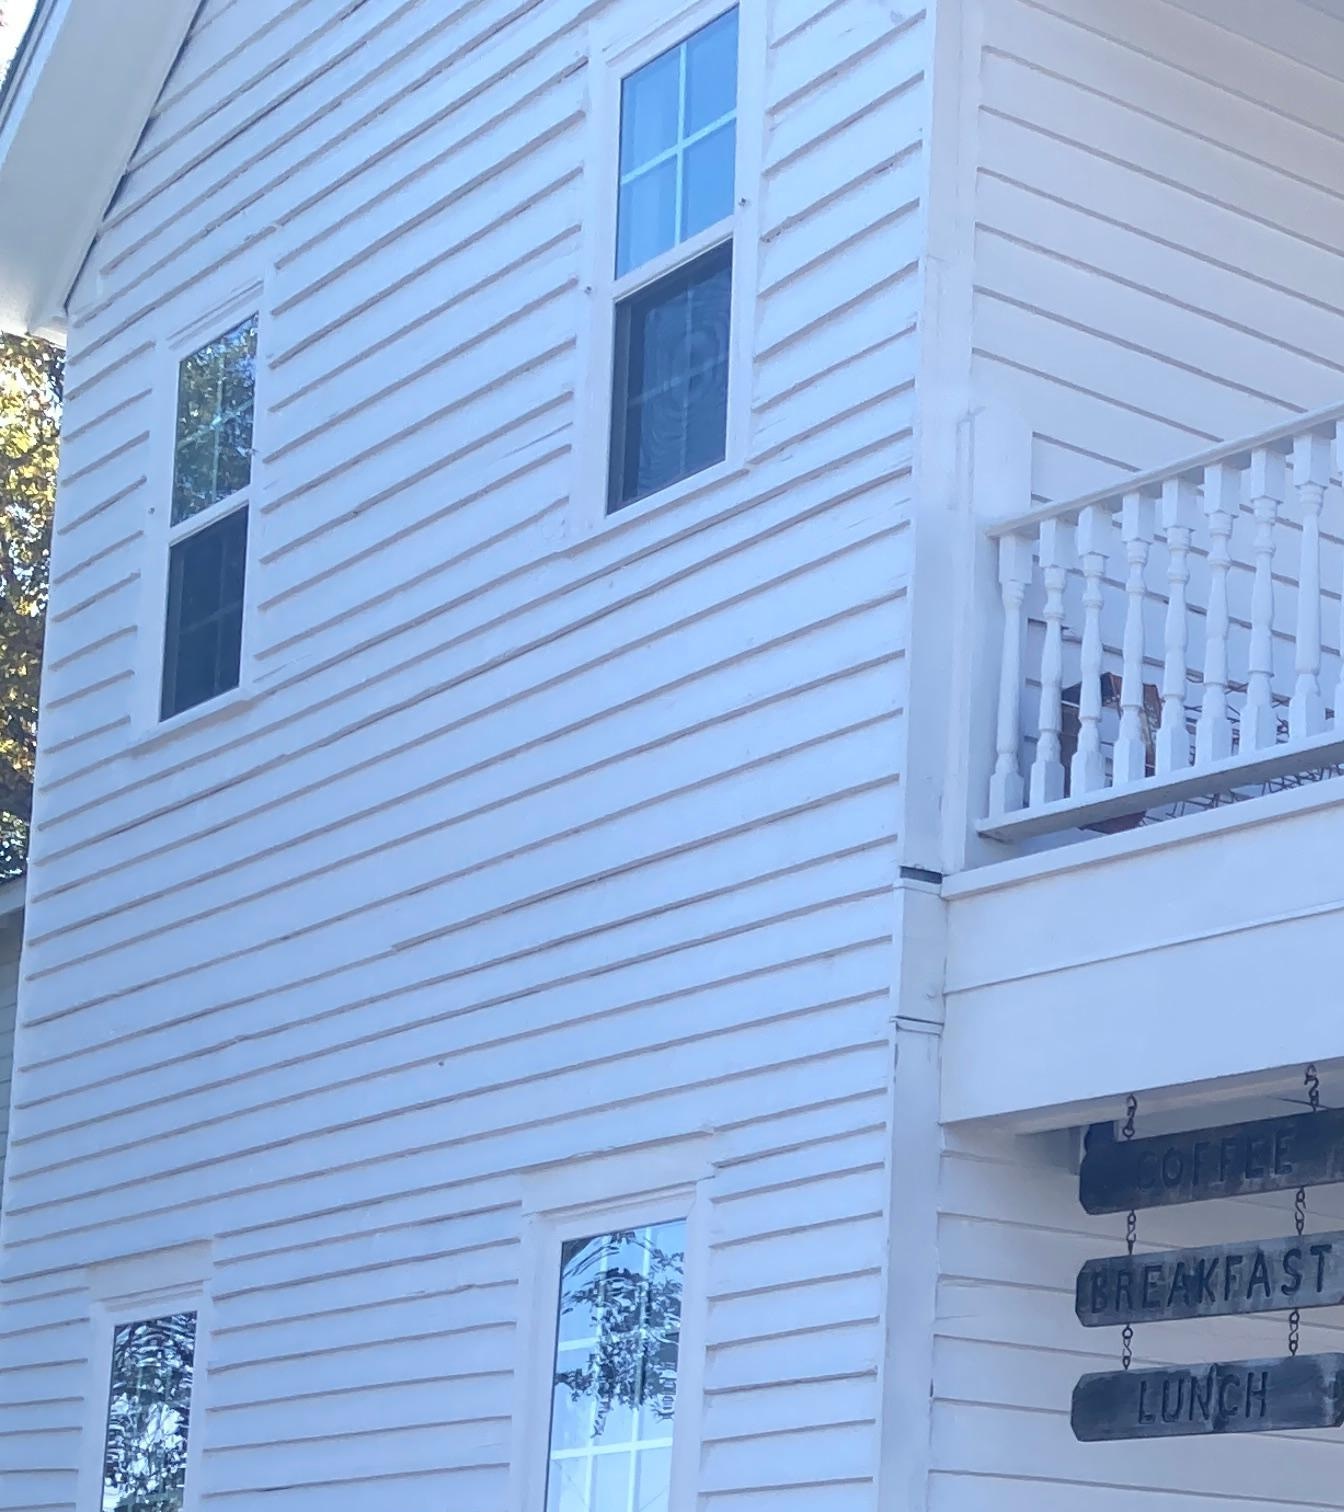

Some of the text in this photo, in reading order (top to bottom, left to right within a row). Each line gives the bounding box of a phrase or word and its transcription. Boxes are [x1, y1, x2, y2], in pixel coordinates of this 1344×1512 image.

[1138, 1130, 1293, 1190] COFFEE
[1090, 1244, 1333, 1314] BREAKFAST
[1138, 1370, 1269, 1425] LUNCH
